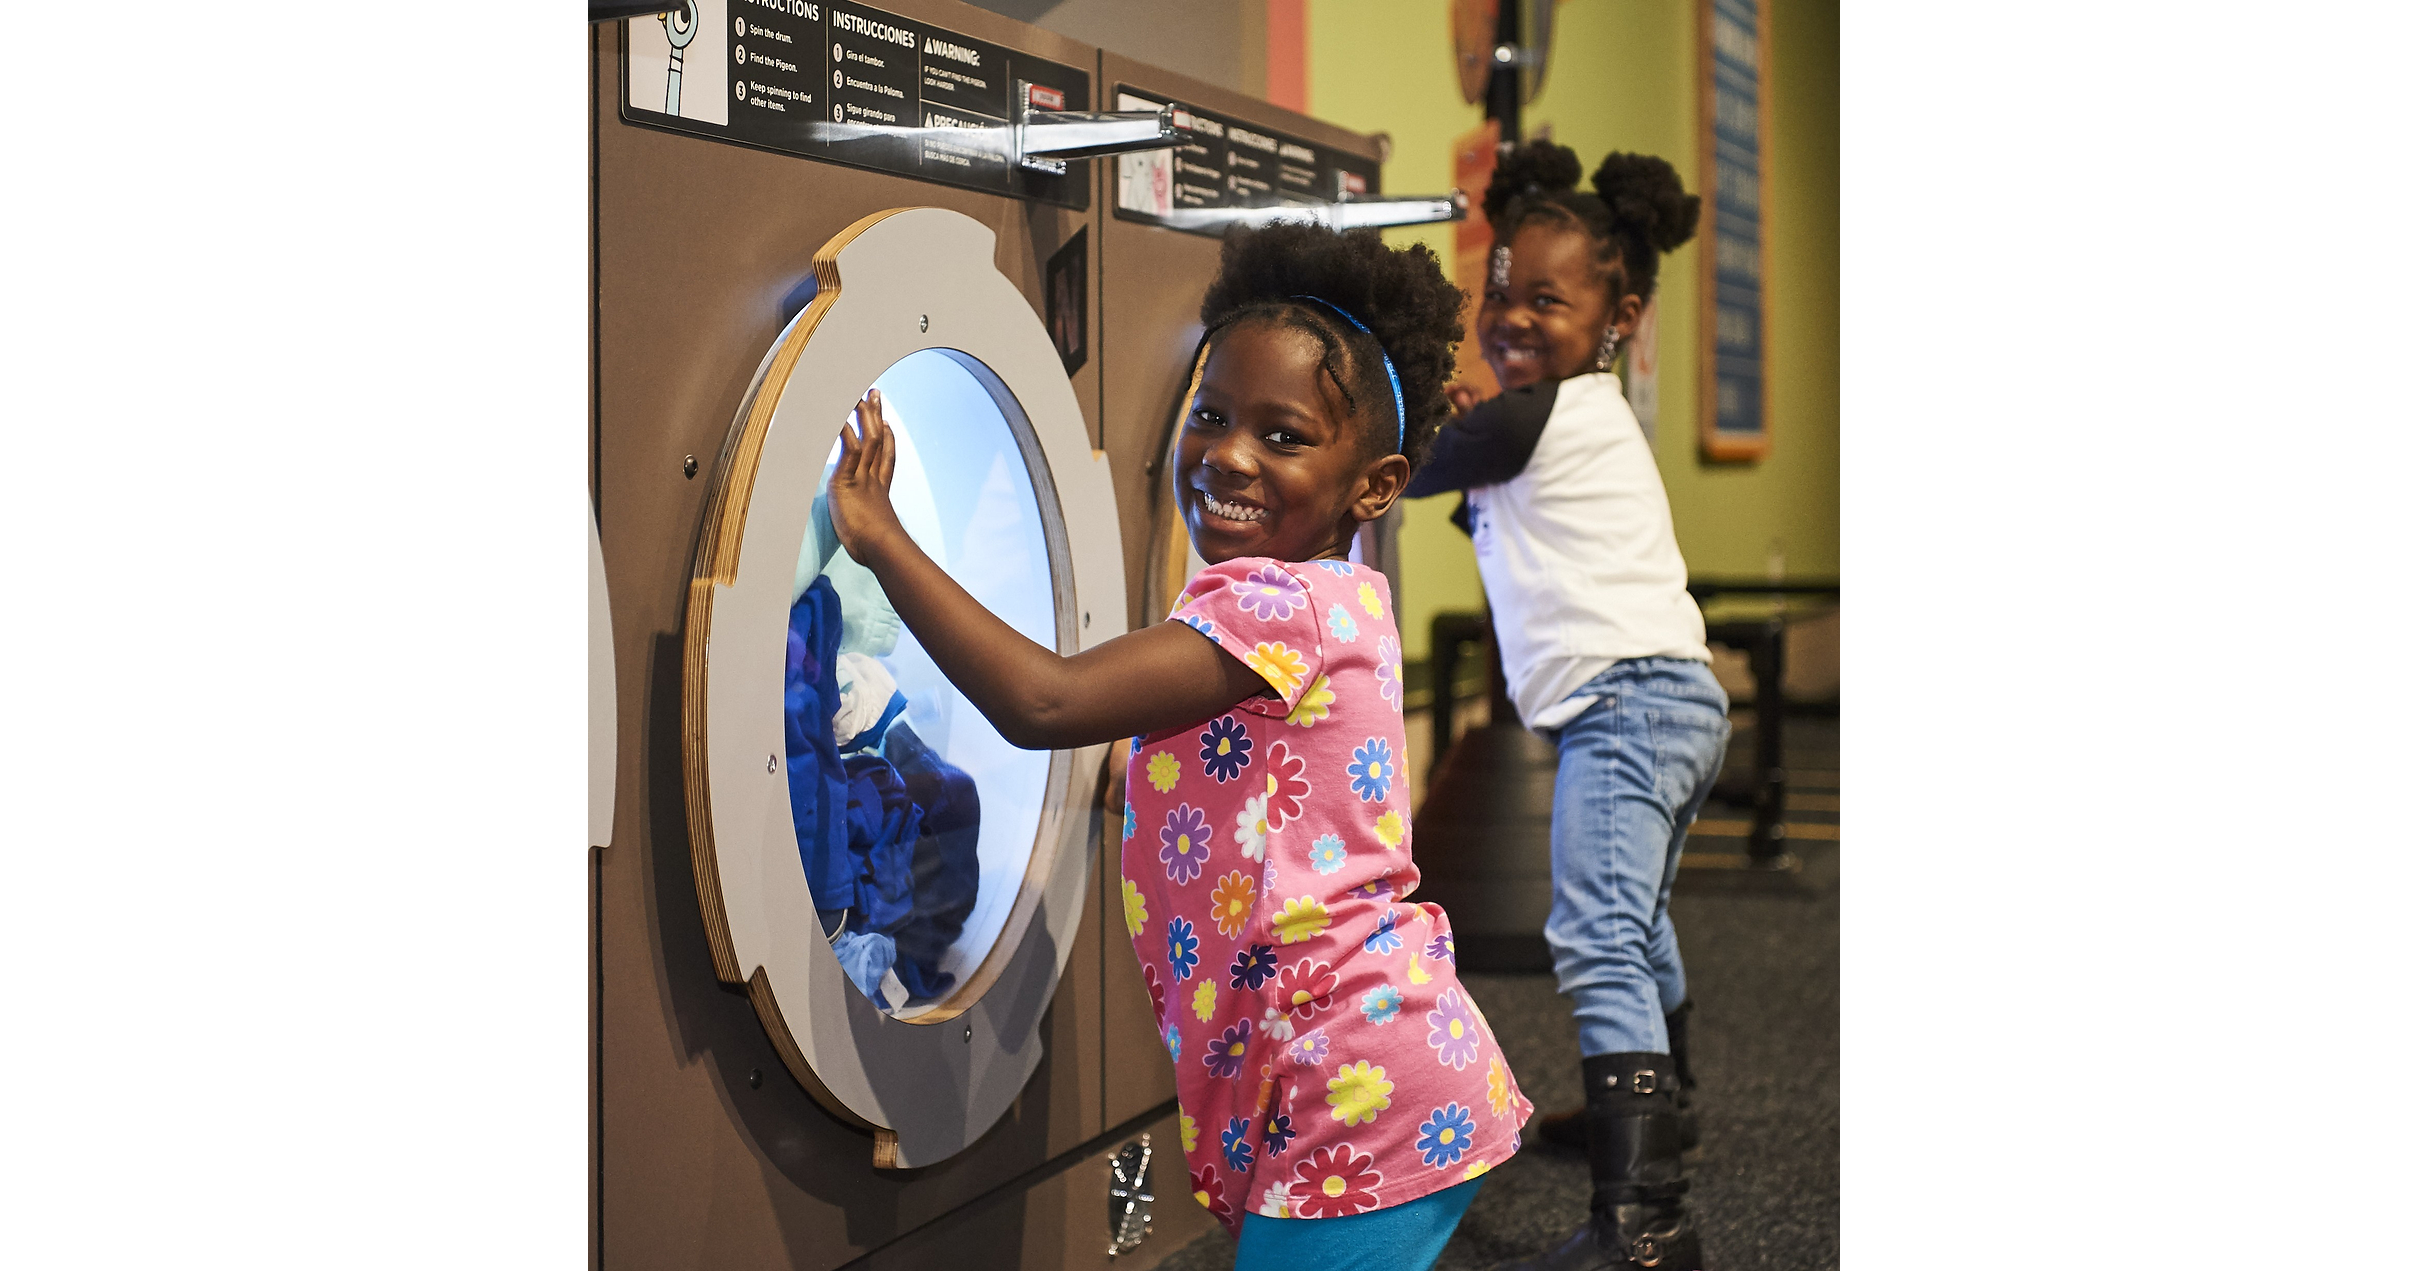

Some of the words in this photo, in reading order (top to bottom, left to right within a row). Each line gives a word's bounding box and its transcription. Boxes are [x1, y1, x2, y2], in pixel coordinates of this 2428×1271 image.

[749, 23, 764, 37] Spin
[764, 28, 775, 39] the
[775, 31, 793, 44] drum.
[833, 10, 916, 49] INSTRUCCIONES
[750, 52, 764, 64] Find
[764, 55, 775, 67] the
[775, 59, 798, 73] Pigeon.
[846, 49, 858, 62] Gira
[858, 53, 864, 62] el
[864, 54, 885, 68] tambor.
[932, 38, 981, 67] WARNING:
[750, 80, 766, 94] Keep
[766, 85, 792, 101] spinning
[792, 90, 799, 101] to
[799, 91, 812, 103] find
[846, 76, 874, 93] Encuentra
[873, 85, 878, 93] a
[878, 84, 884, 94] la
[883, 85, 905, 99] Paloma.
[750, 97, 767, 108] other
[767, 99, 786, 112] items.
[846, 102, 862, 115] Sigue
[862, 106, 883, 120] girando
[883, 113, 896, 123] para
